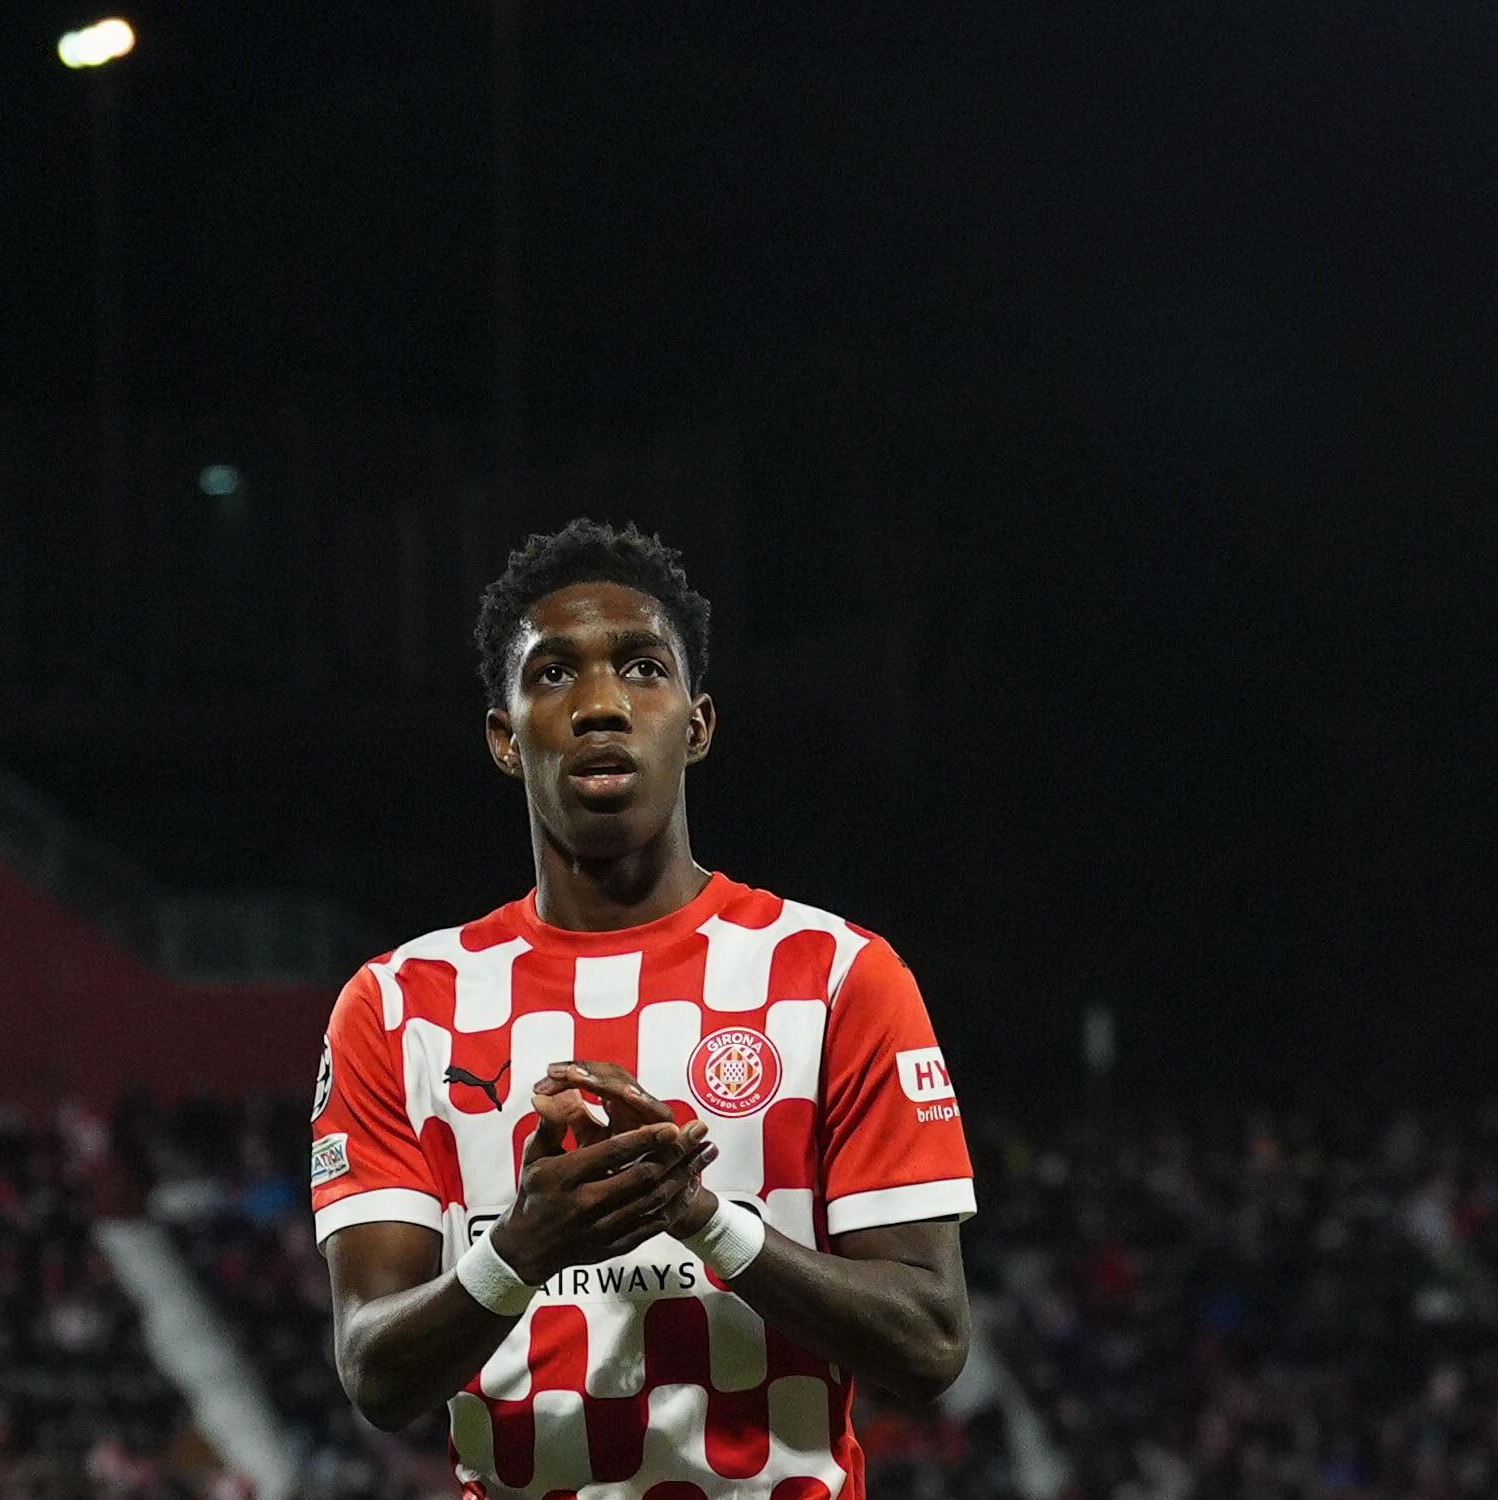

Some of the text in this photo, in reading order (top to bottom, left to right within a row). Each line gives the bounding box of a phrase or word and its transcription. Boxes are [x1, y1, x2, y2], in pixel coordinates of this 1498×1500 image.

[706, 1032, 763, 1054] GIRONA
[705, 1092, 761, 1110] FUTBOL CLUB
